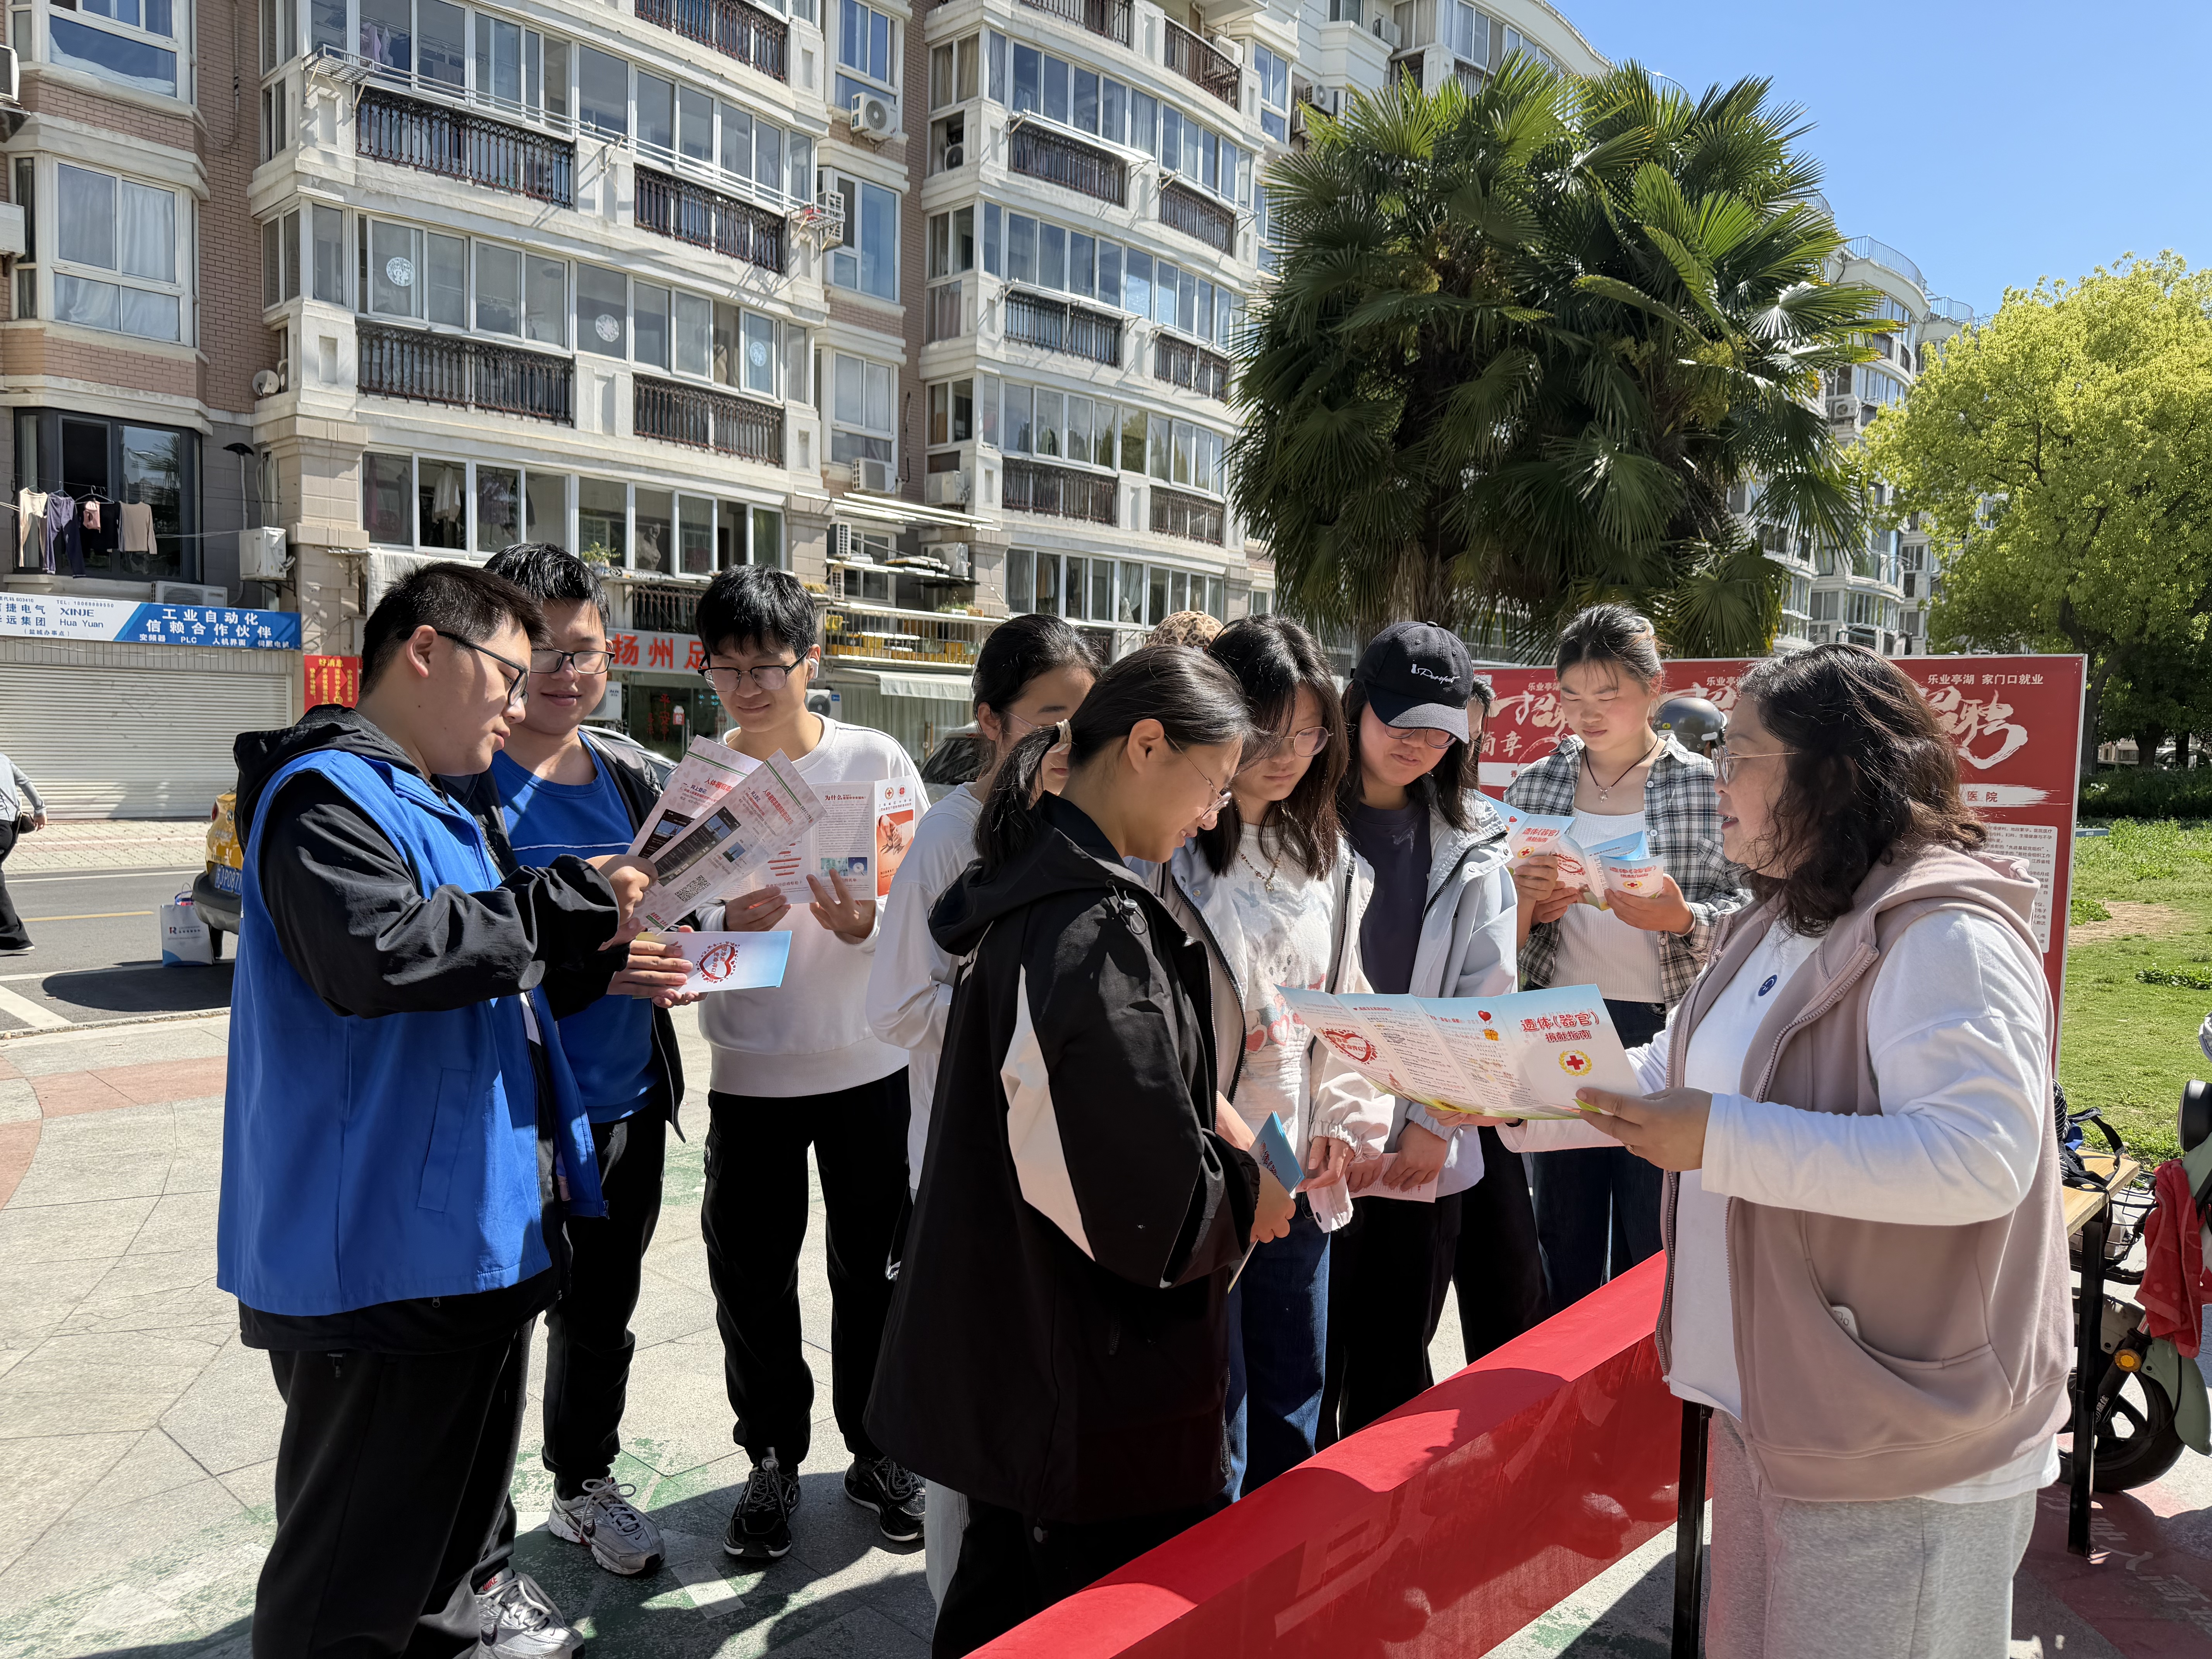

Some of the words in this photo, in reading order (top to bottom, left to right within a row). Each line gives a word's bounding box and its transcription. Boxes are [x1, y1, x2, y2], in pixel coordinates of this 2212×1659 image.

[60, 608, 94, 617] XINJE
[162, 608, 259, 625] 工业自动化
[82, 620, 104, 628] Yuan
[146, 619, 272, 638] 信赖合作伙伴
[139, 633, 166, 642] 变频器
[213, 637, 246, 647] 人机界面
[1707, 677, 1740, 686] 乐业亭
[1928, 674, 1975, 685] 乐业亭湖
[1982, 674, 2044, 685] 家门口就业
[1967, 791, 1998, 803] 医院
[1520, 1010, 1600, 1032] 遗体(器官)
[1546, 1030, 1592, 1043] 捐献指南
[483, 1575, 498, 1591] NIKE
